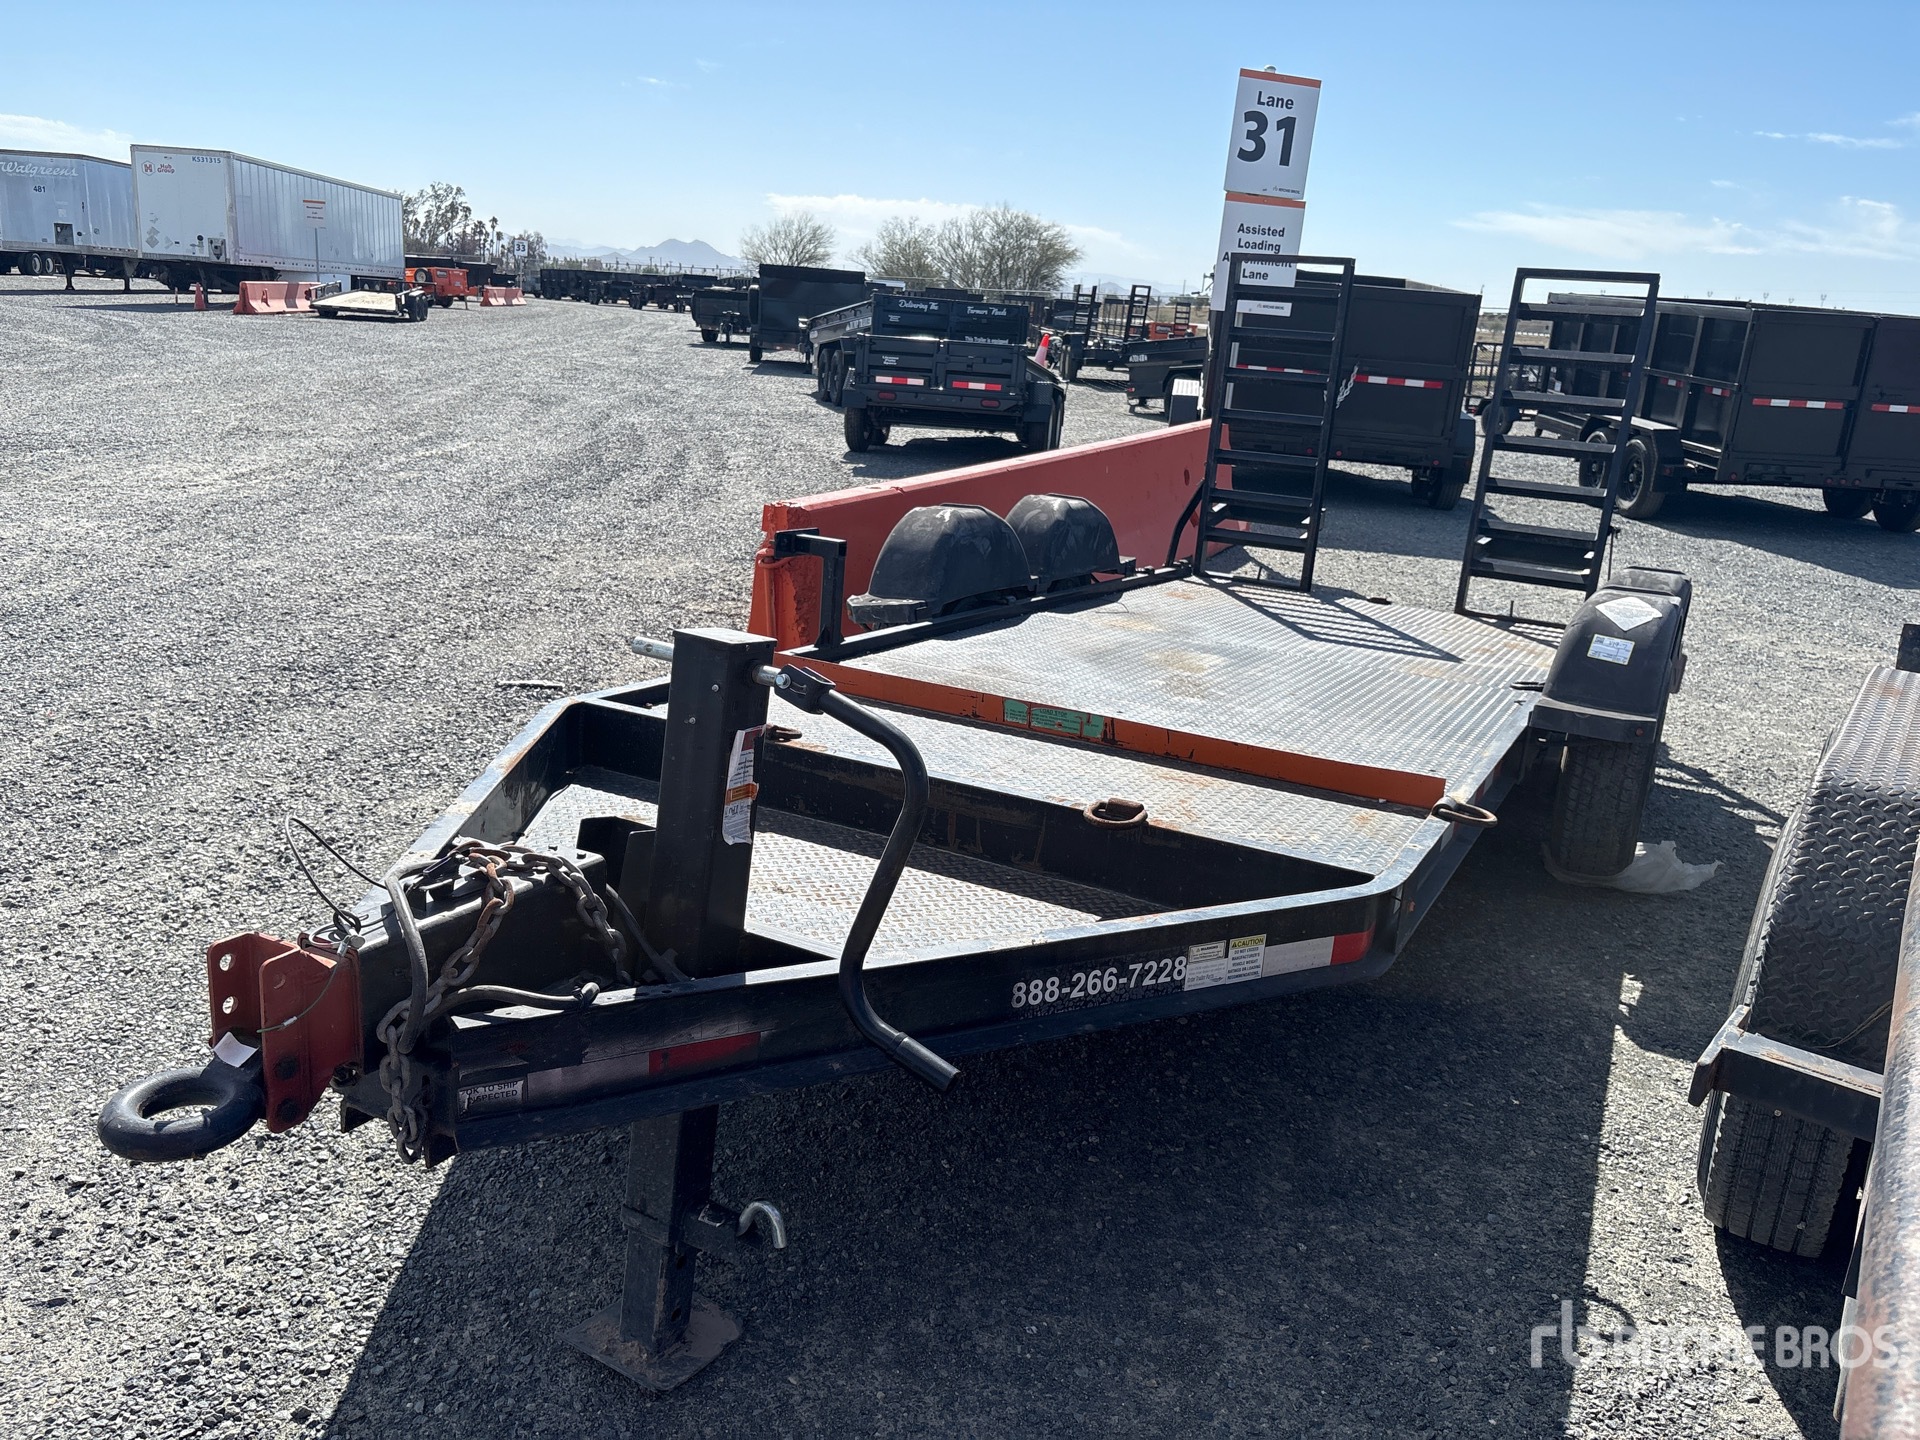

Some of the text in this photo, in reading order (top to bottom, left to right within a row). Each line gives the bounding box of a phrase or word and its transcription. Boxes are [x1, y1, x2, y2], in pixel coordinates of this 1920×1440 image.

[1257, 91, 1294, 109] Lane
[1237, 110, 1297, 167] 31
[0, 161, 79, 178] Walgreens
[33, 185, 46, 193] 481
[1237, 223, 1285, 237] Assisted
[516, 243, 526, 252] 33
[1237, 238, 1281, 254] Loading
[1242, 268, 1269, 280] Lane
[899, 300, 928, 312] Delivering
[1238, 938, 1264, 948] CAUTION
[1011, 956, 1187, 1008] 888-266-7228
[466, 1081, 518, 1096] OK TO SHIP
